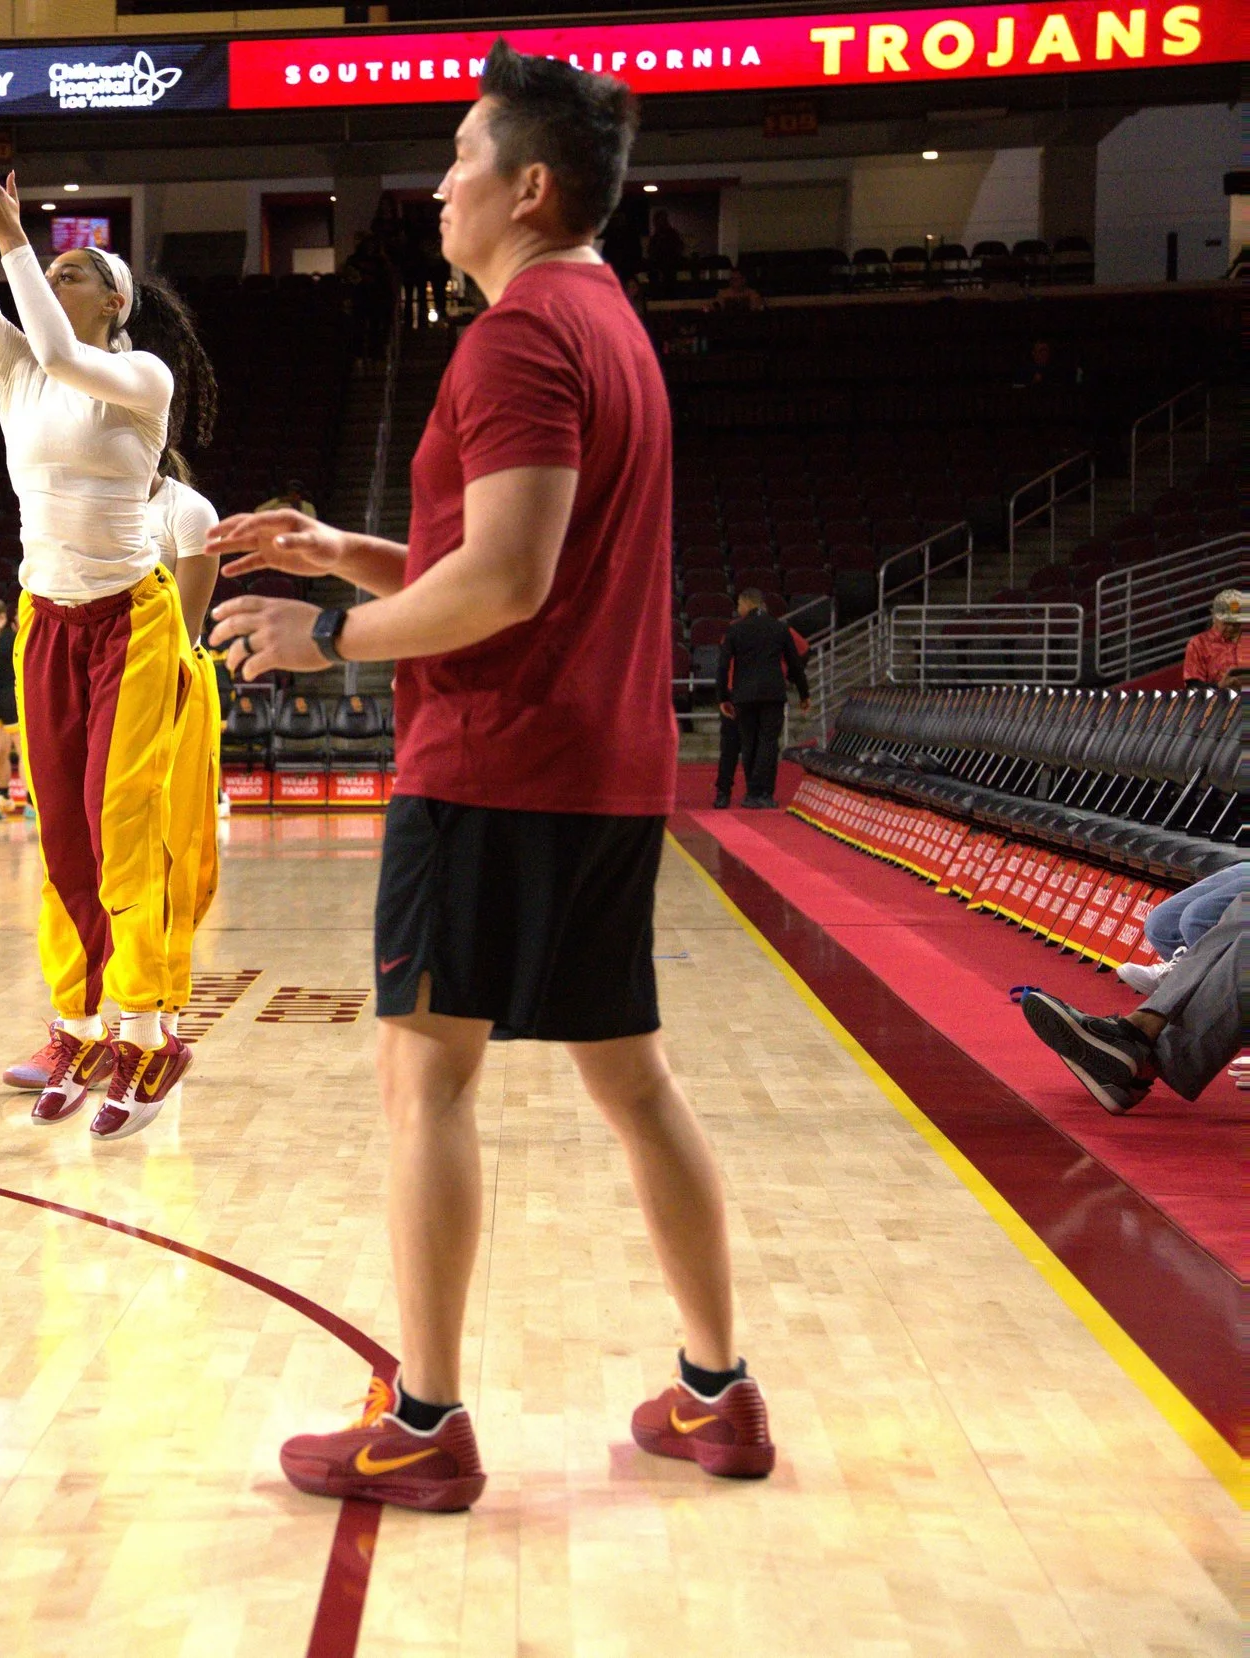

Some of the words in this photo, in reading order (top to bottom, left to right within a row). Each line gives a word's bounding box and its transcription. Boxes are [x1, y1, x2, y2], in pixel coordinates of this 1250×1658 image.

[810, 5, 1202, 75] TROJANS
[285, 58, 487, 85] SOUTHERN
[546, 46, 761, 72] LIFORNIA
[50, 77, 131, 100] Hospital
[254, 986, 371, 1024] COURT
